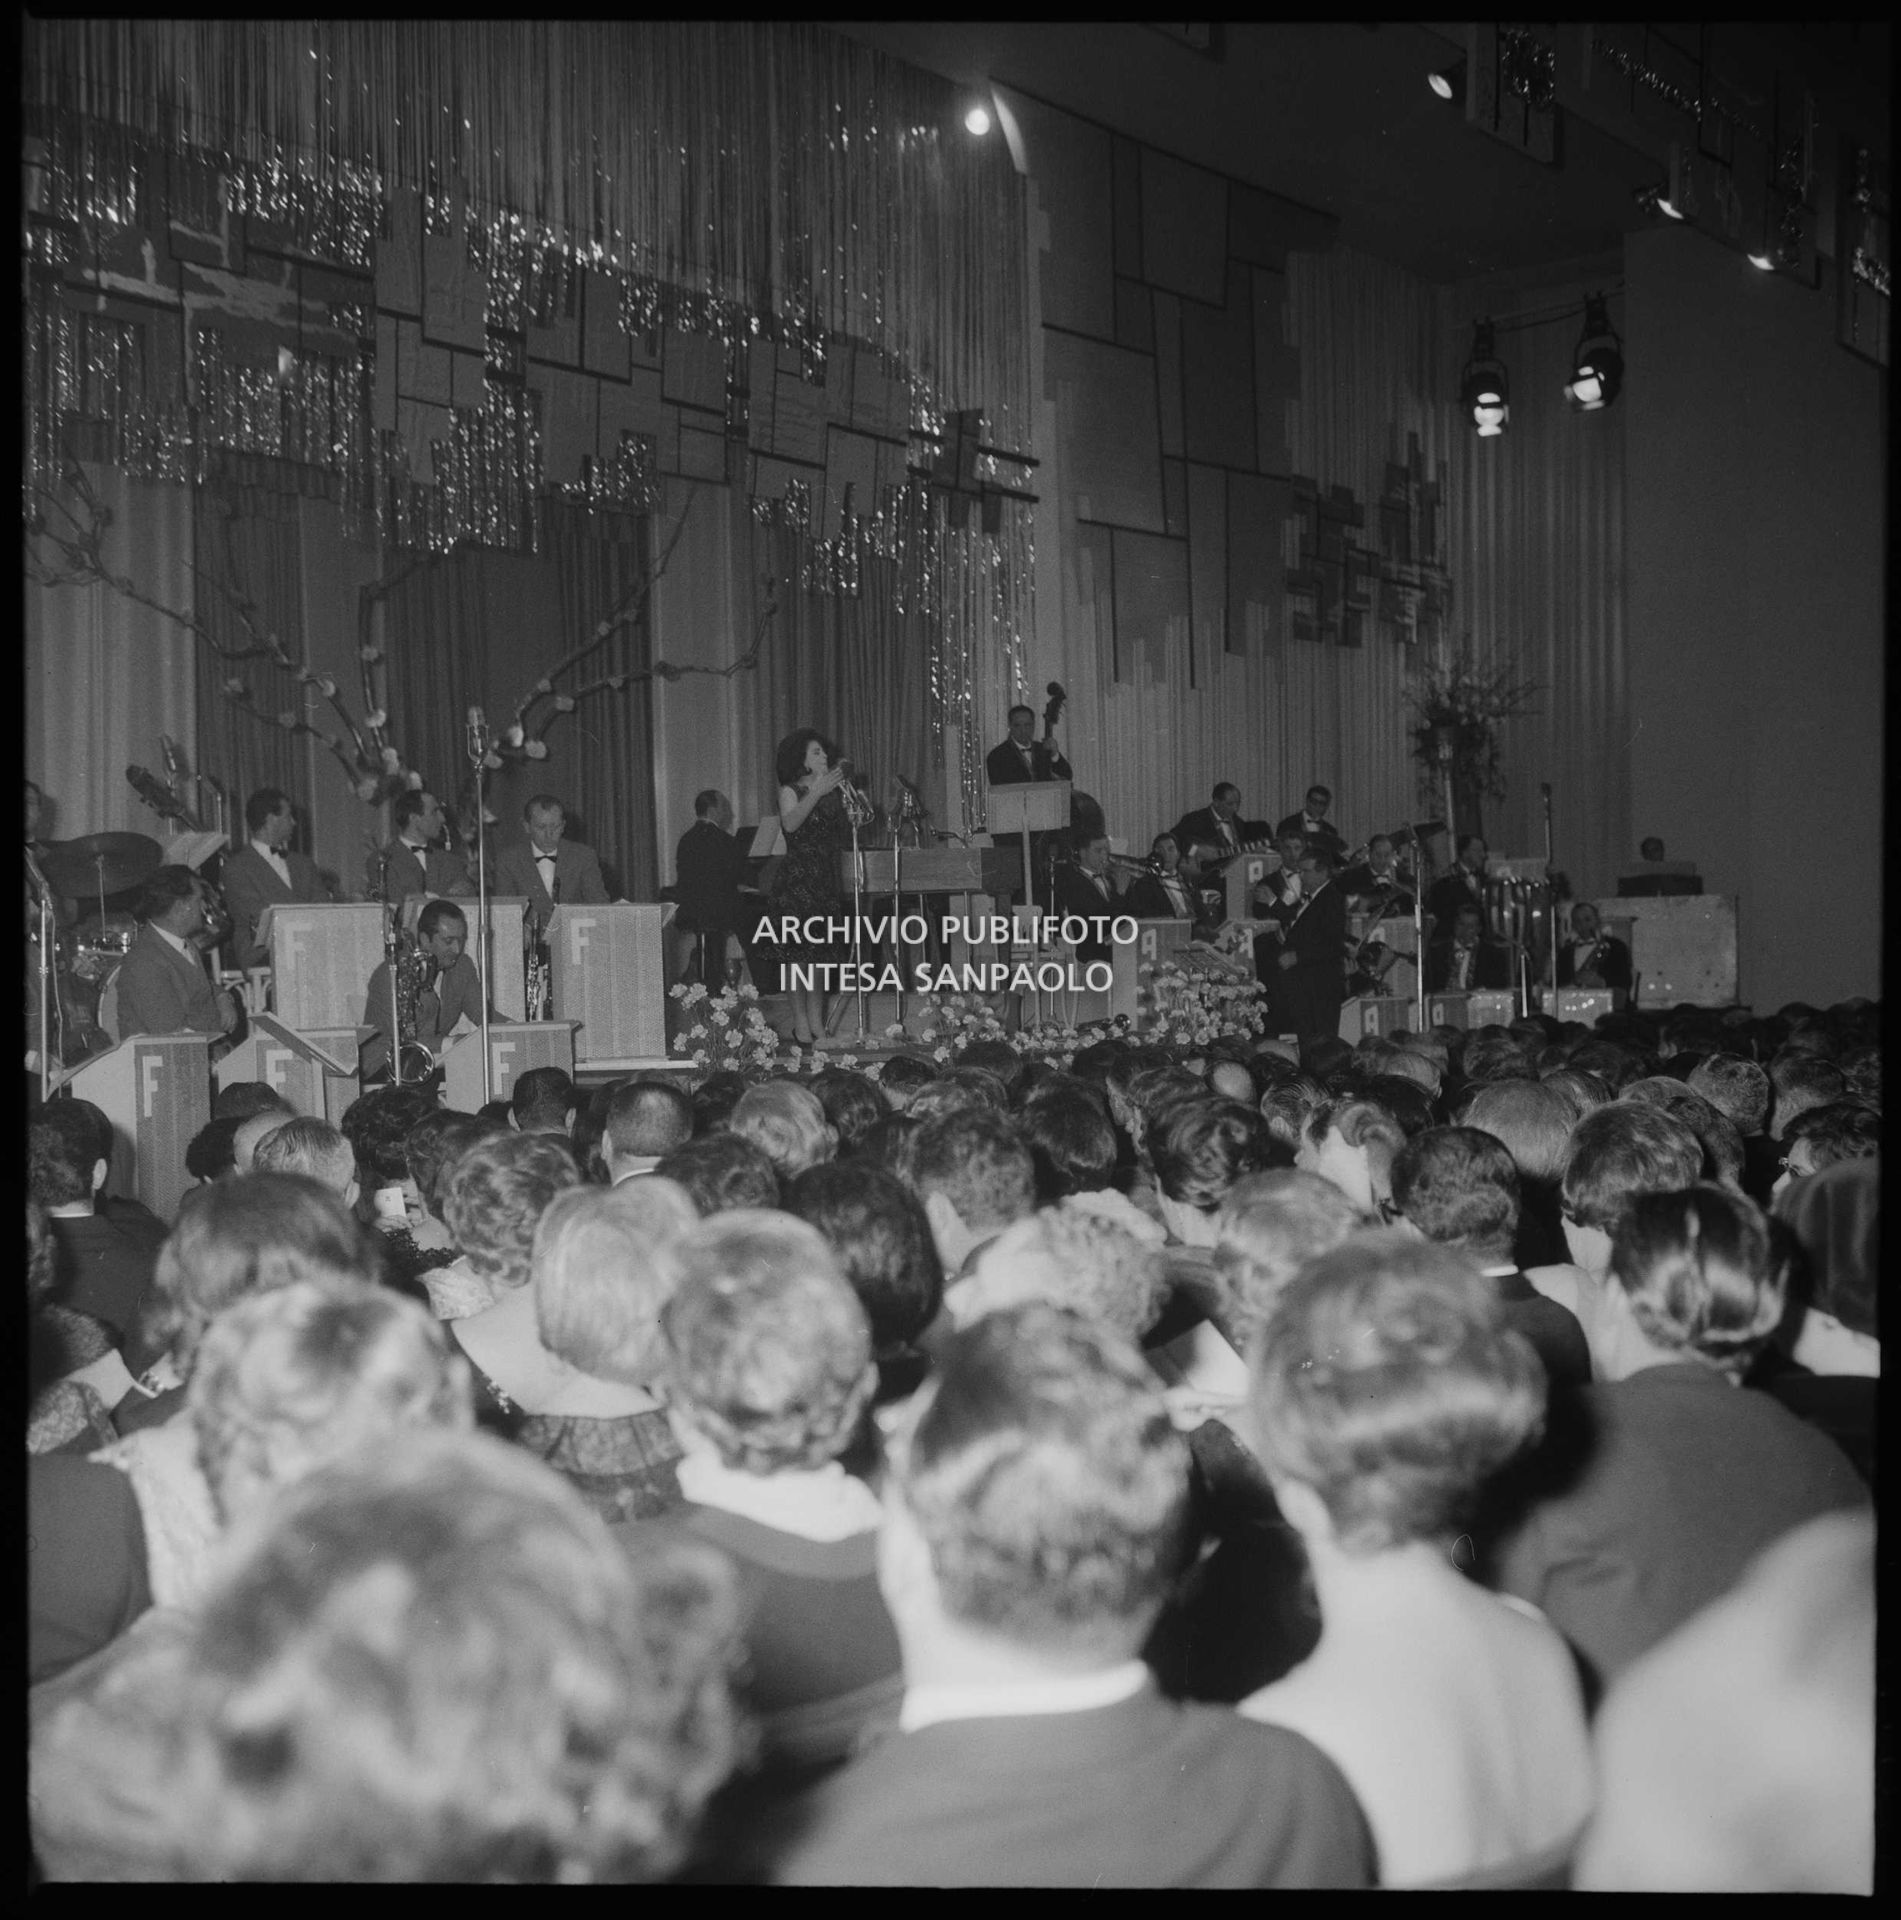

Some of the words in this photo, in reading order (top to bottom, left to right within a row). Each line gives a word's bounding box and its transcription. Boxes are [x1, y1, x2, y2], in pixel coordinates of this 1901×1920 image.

[284, 922, 312, 970] F
[570, 918, 597, 965] F
[1141, 928, 1157, 960] A
[1364, 1004, 1380, 1036] A
[142, 1055, 164, 1118] F
[265, 1049, 294, 1092] F
[491, 1041, 517, 1096] F
